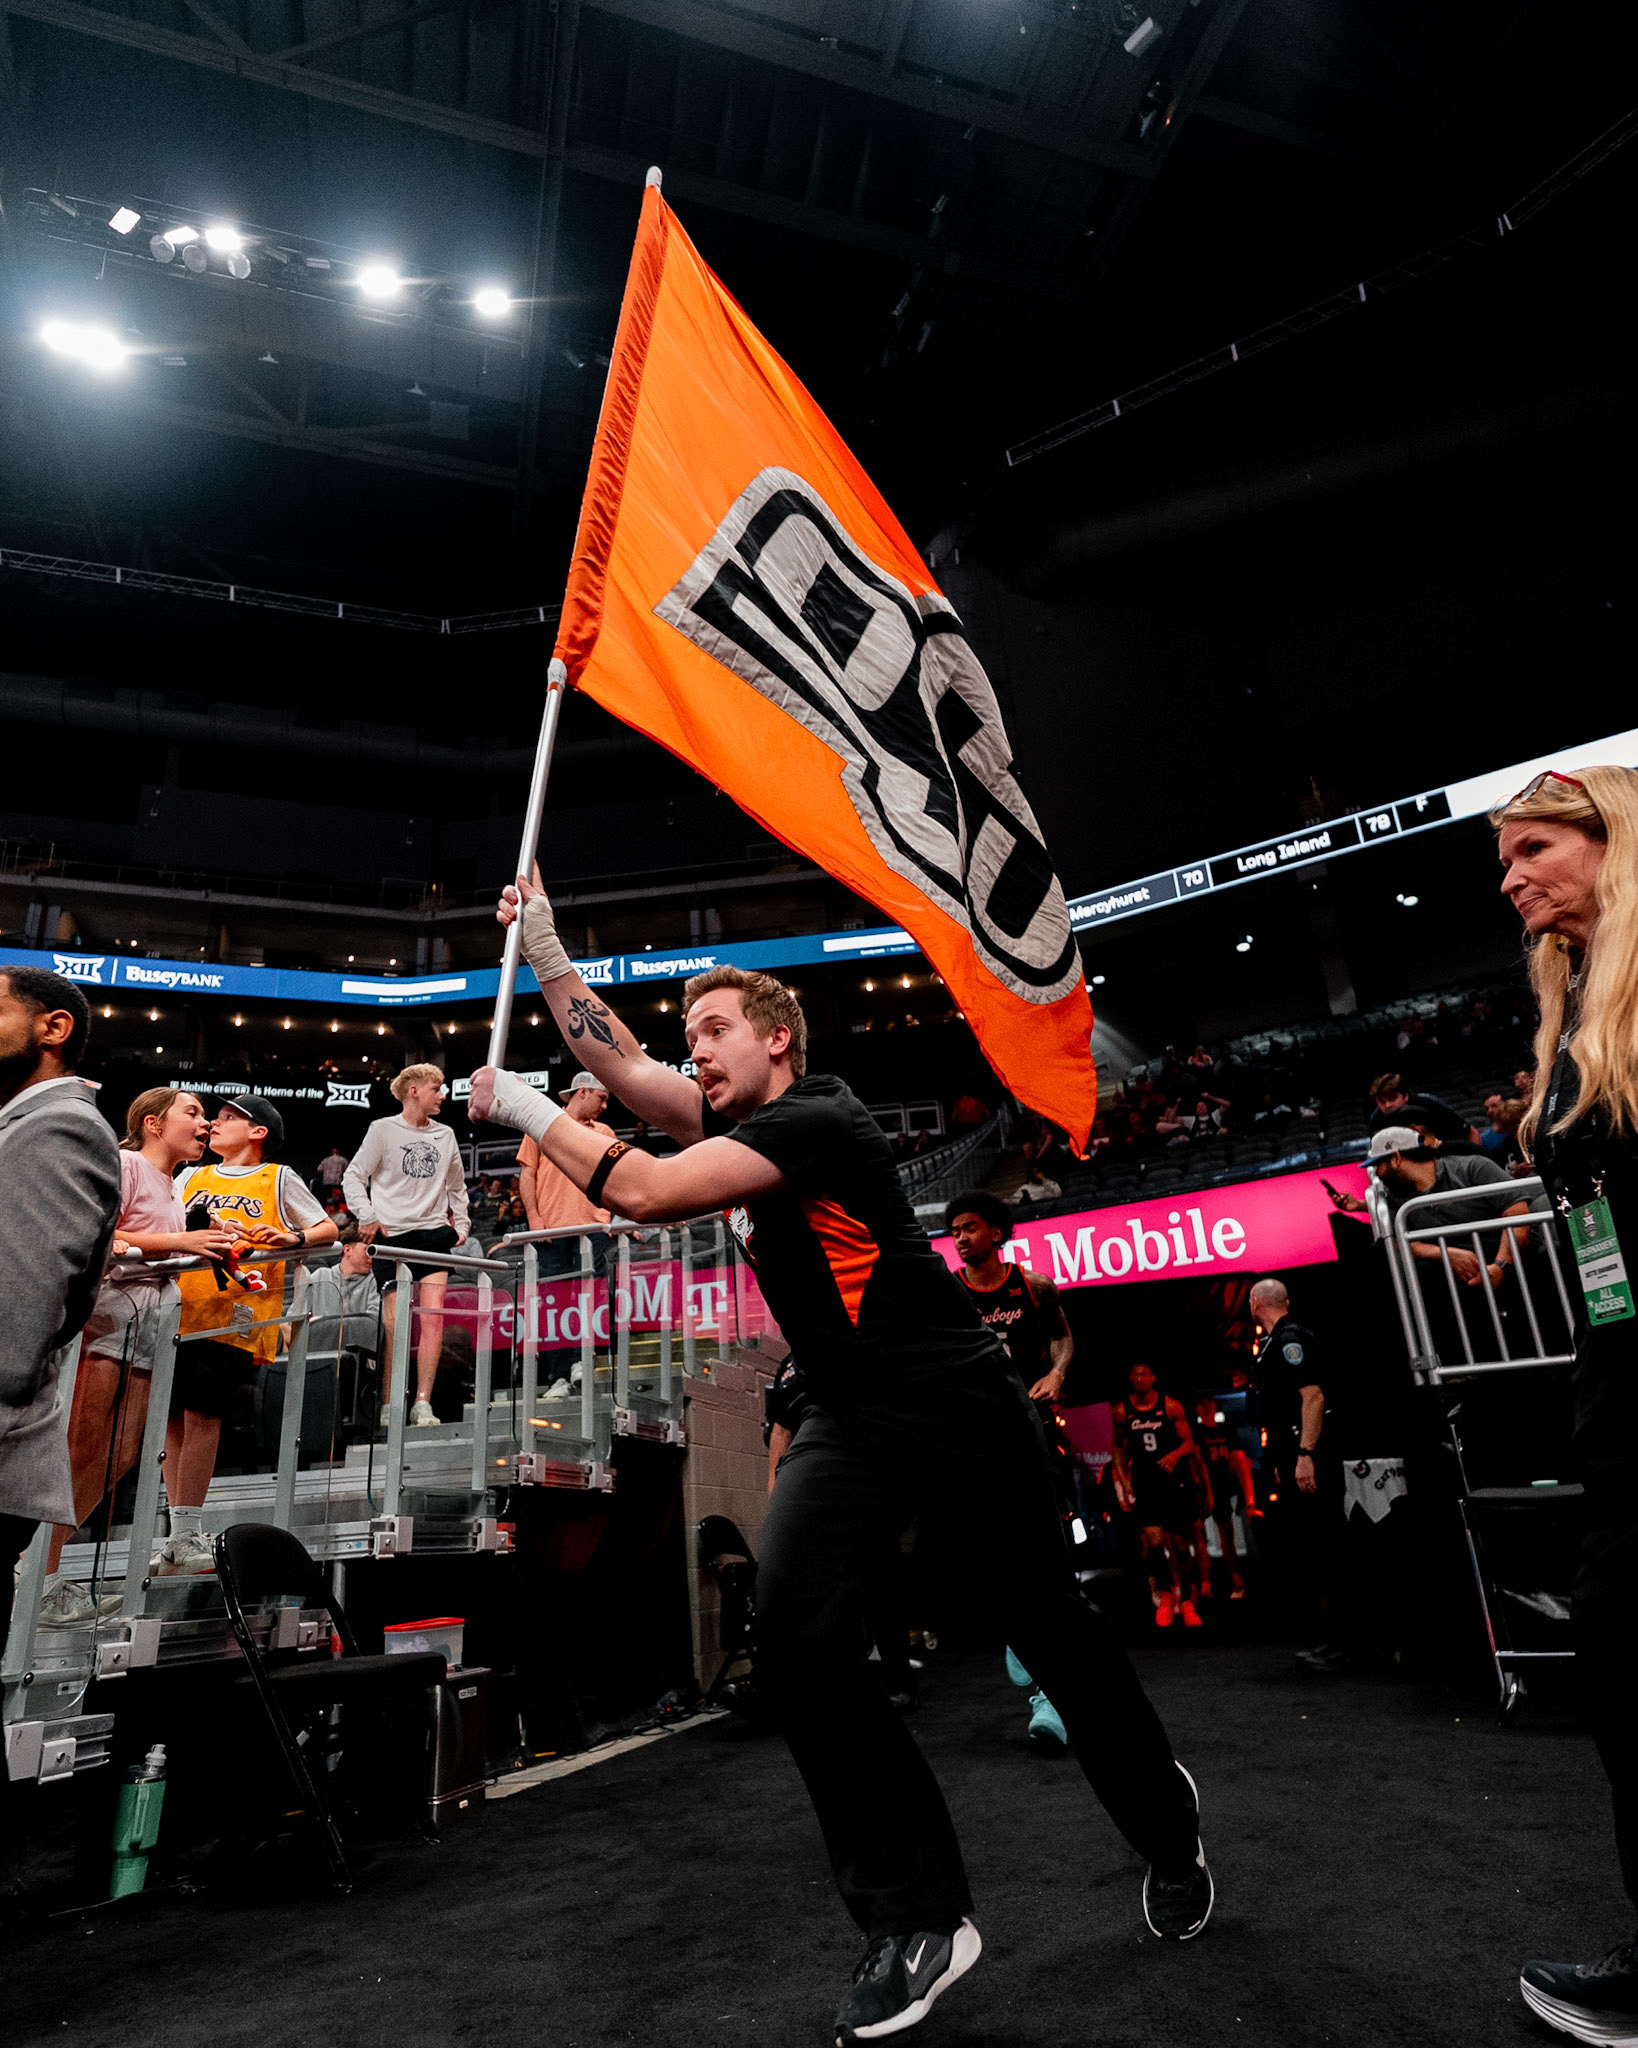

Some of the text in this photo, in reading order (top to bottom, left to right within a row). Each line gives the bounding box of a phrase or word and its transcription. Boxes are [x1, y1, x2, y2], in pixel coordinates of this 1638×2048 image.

[1069, 887, 1150, 921] Mercyhurst
[1182, 870, 1204, 887] 70
[1237, 850, 1277, 872] Long
[1277, 831, 1331, 860] Island
[1416, 795, 1428, 812] F
[263, 1086, 294, 1098] Home
[295, 1087, 307, 1098] of
[307, 1088, 324, 1099] the
[1044, 1207, 1247, 1286] Mobile
[1600, 1287, 1615, 1300] ALL
[1594, 1296, 1627, 1315] ACCESS
[1143, 1433, 1157, 1452] 9
